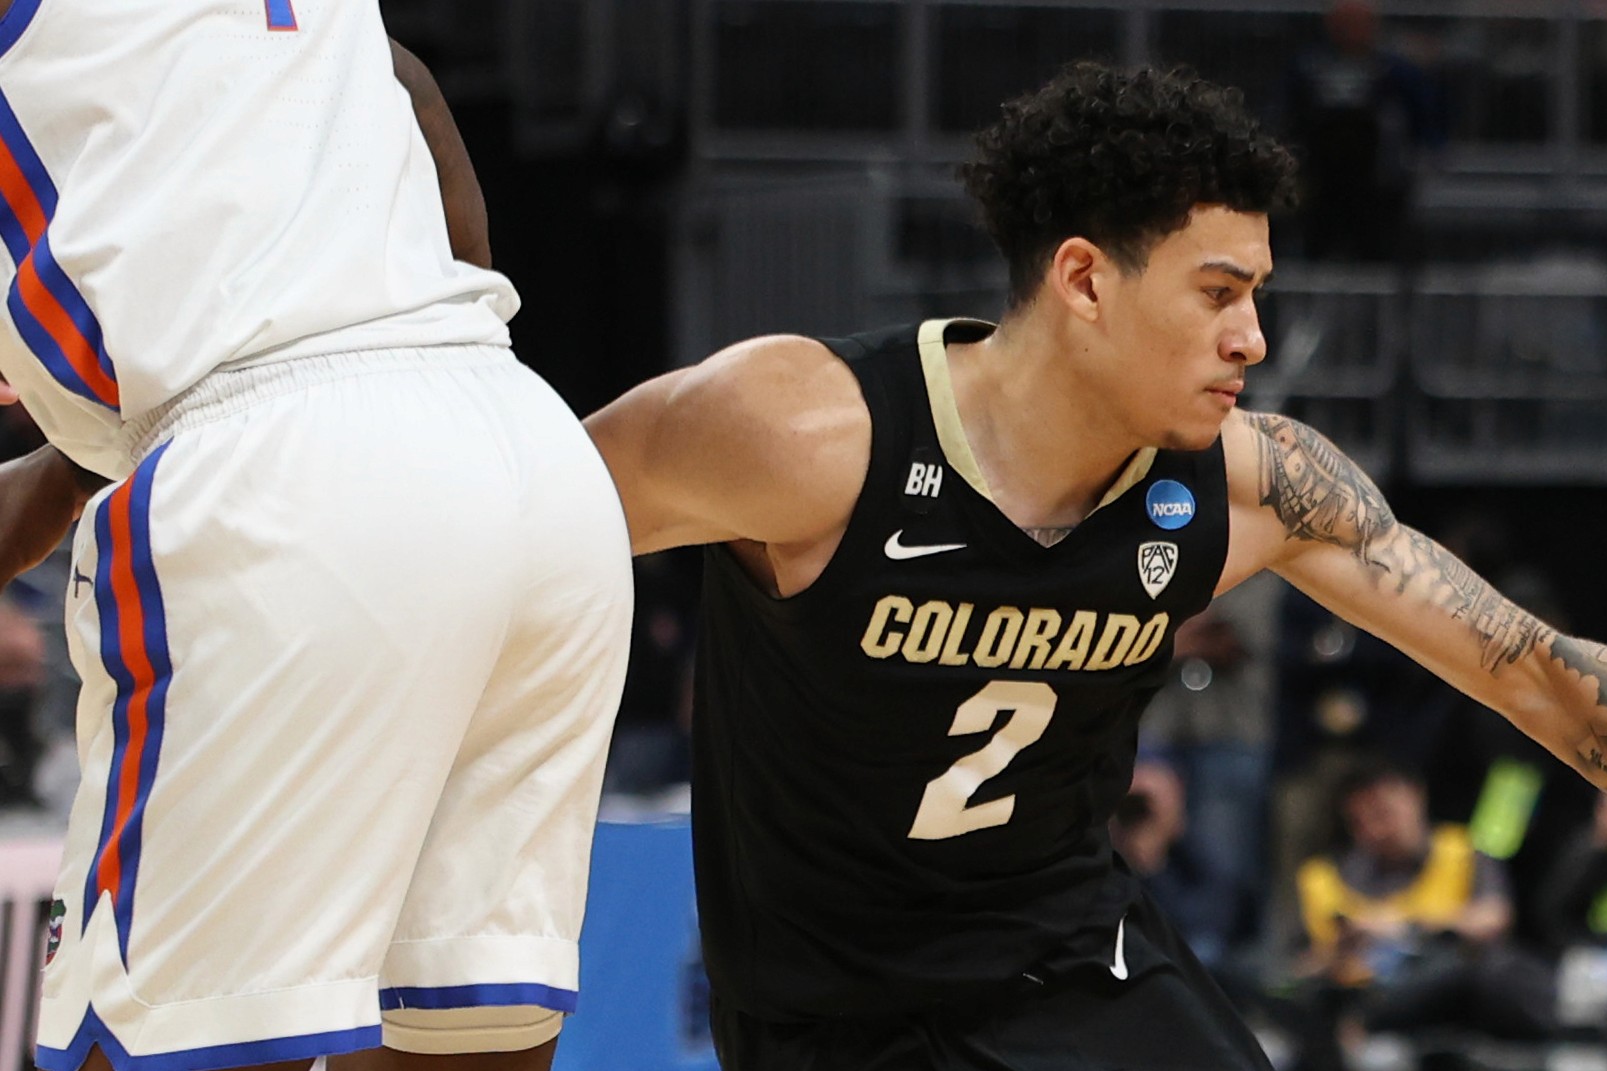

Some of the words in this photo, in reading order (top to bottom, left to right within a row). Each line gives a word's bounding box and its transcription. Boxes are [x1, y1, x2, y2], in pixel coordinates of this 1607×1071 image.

[904, 463, 943, 498] BH
[1152, 502, 1192, 517] NCAA
[1141, 545, 1175, 574] PAC
[1146, 566, 1166, 584] 12
[860, 594, 1169, 671] COLORADO
[907, 679, 1058, 840] 2
